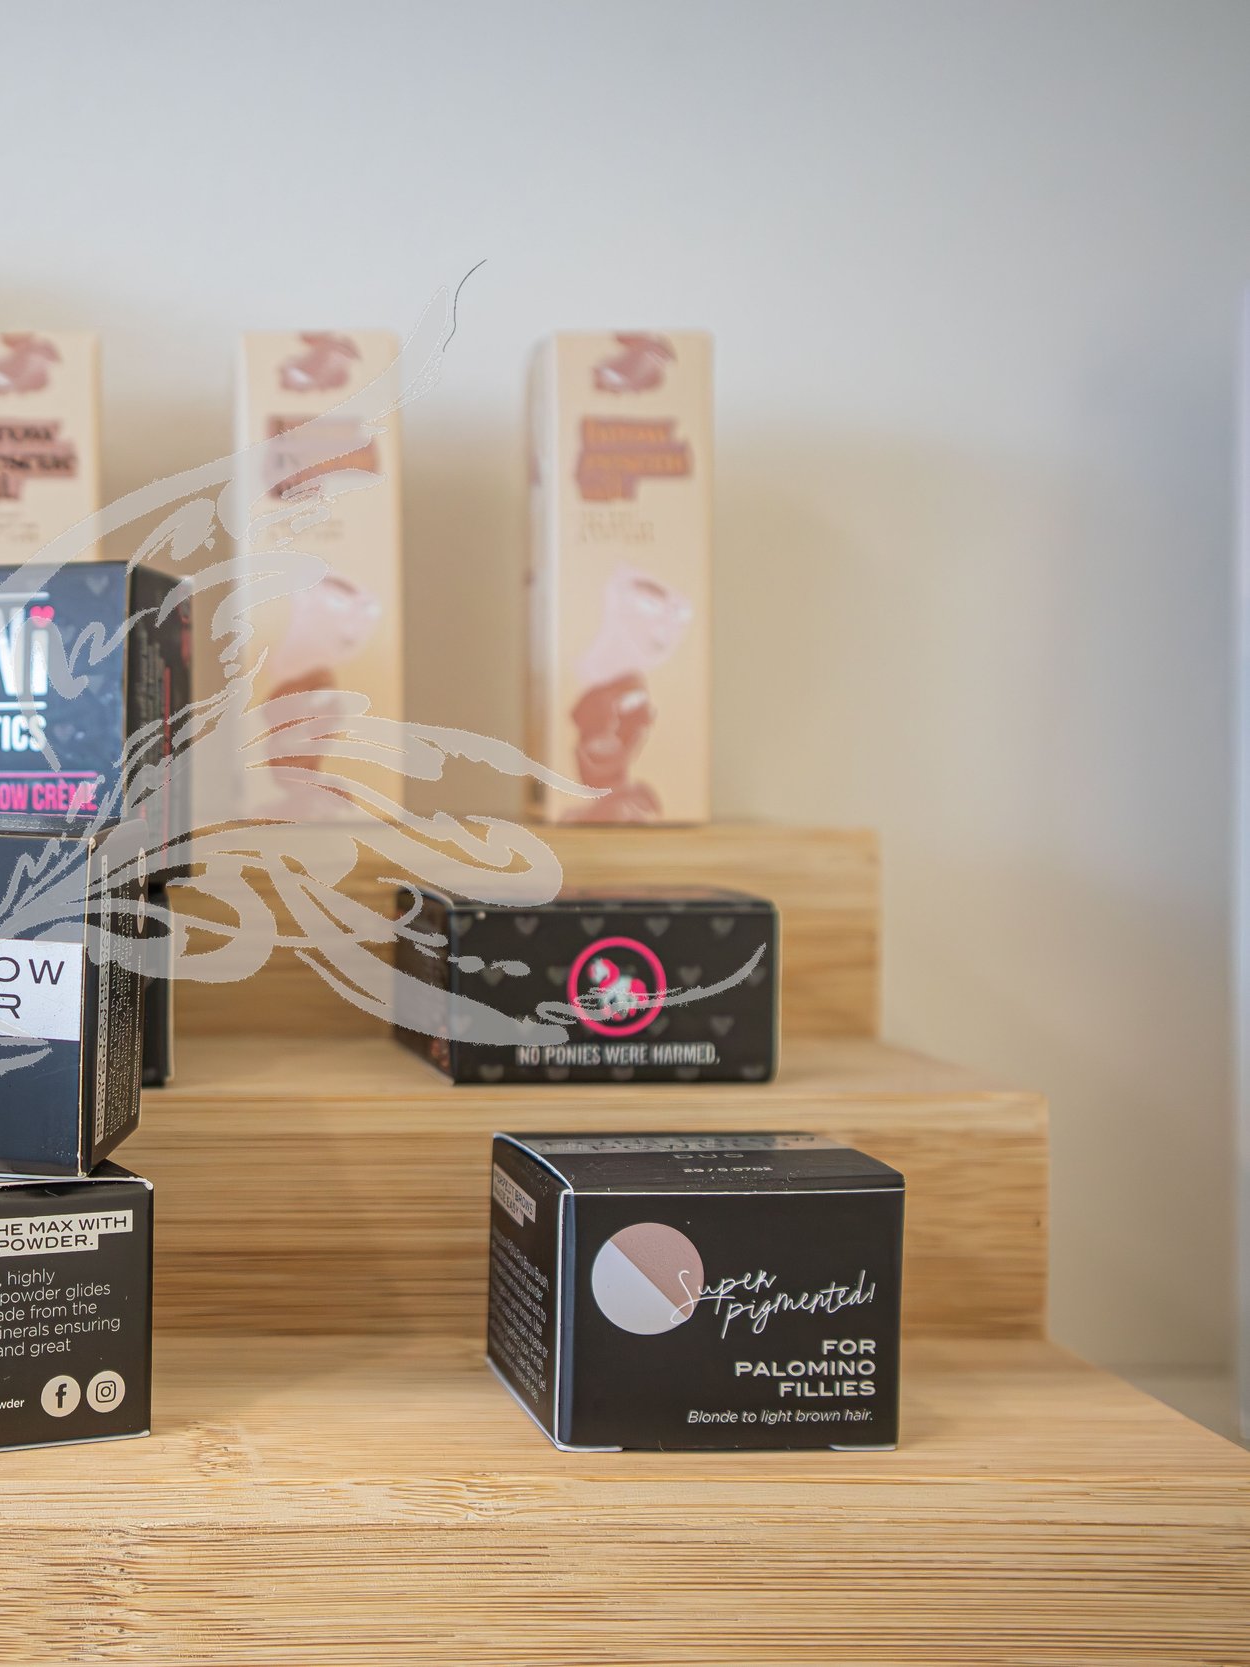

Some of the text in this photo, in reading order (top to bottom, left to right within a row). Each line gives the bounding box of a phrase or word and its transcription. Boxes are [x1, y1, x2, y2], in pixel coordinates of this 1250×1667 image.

[518, 1045, 541, 1066] NO
[544, 1044, 601, 1066] PONIES
[604, 1043, 649, 1066] WERE
[29, 1219, 73, 1235] MAX
[79, 1215, 127, 1231] WITH
[7, 1268, 55, 1286] highly
[0, 1287, 61, 1306] powder
[65, 1283, 111, 1301] glides
[669, 1269, 776, 1324] Super
[721, 1269, 876, 1339] pigmented!
[30, 1304, 67, 1320] from
[72, 1301, 98, 1315] the
[54, 1317, 121, 1335] ensuring
[29, 1338, 72, 1357] great
[822, 1339, 876, 1355] FOR
[734, 1360, 876, 1377] PALOMINO
[779, 1381, 876, 1398] FILLIES
[687, 1408, 873, 1425] Blonde to light brown hair.
